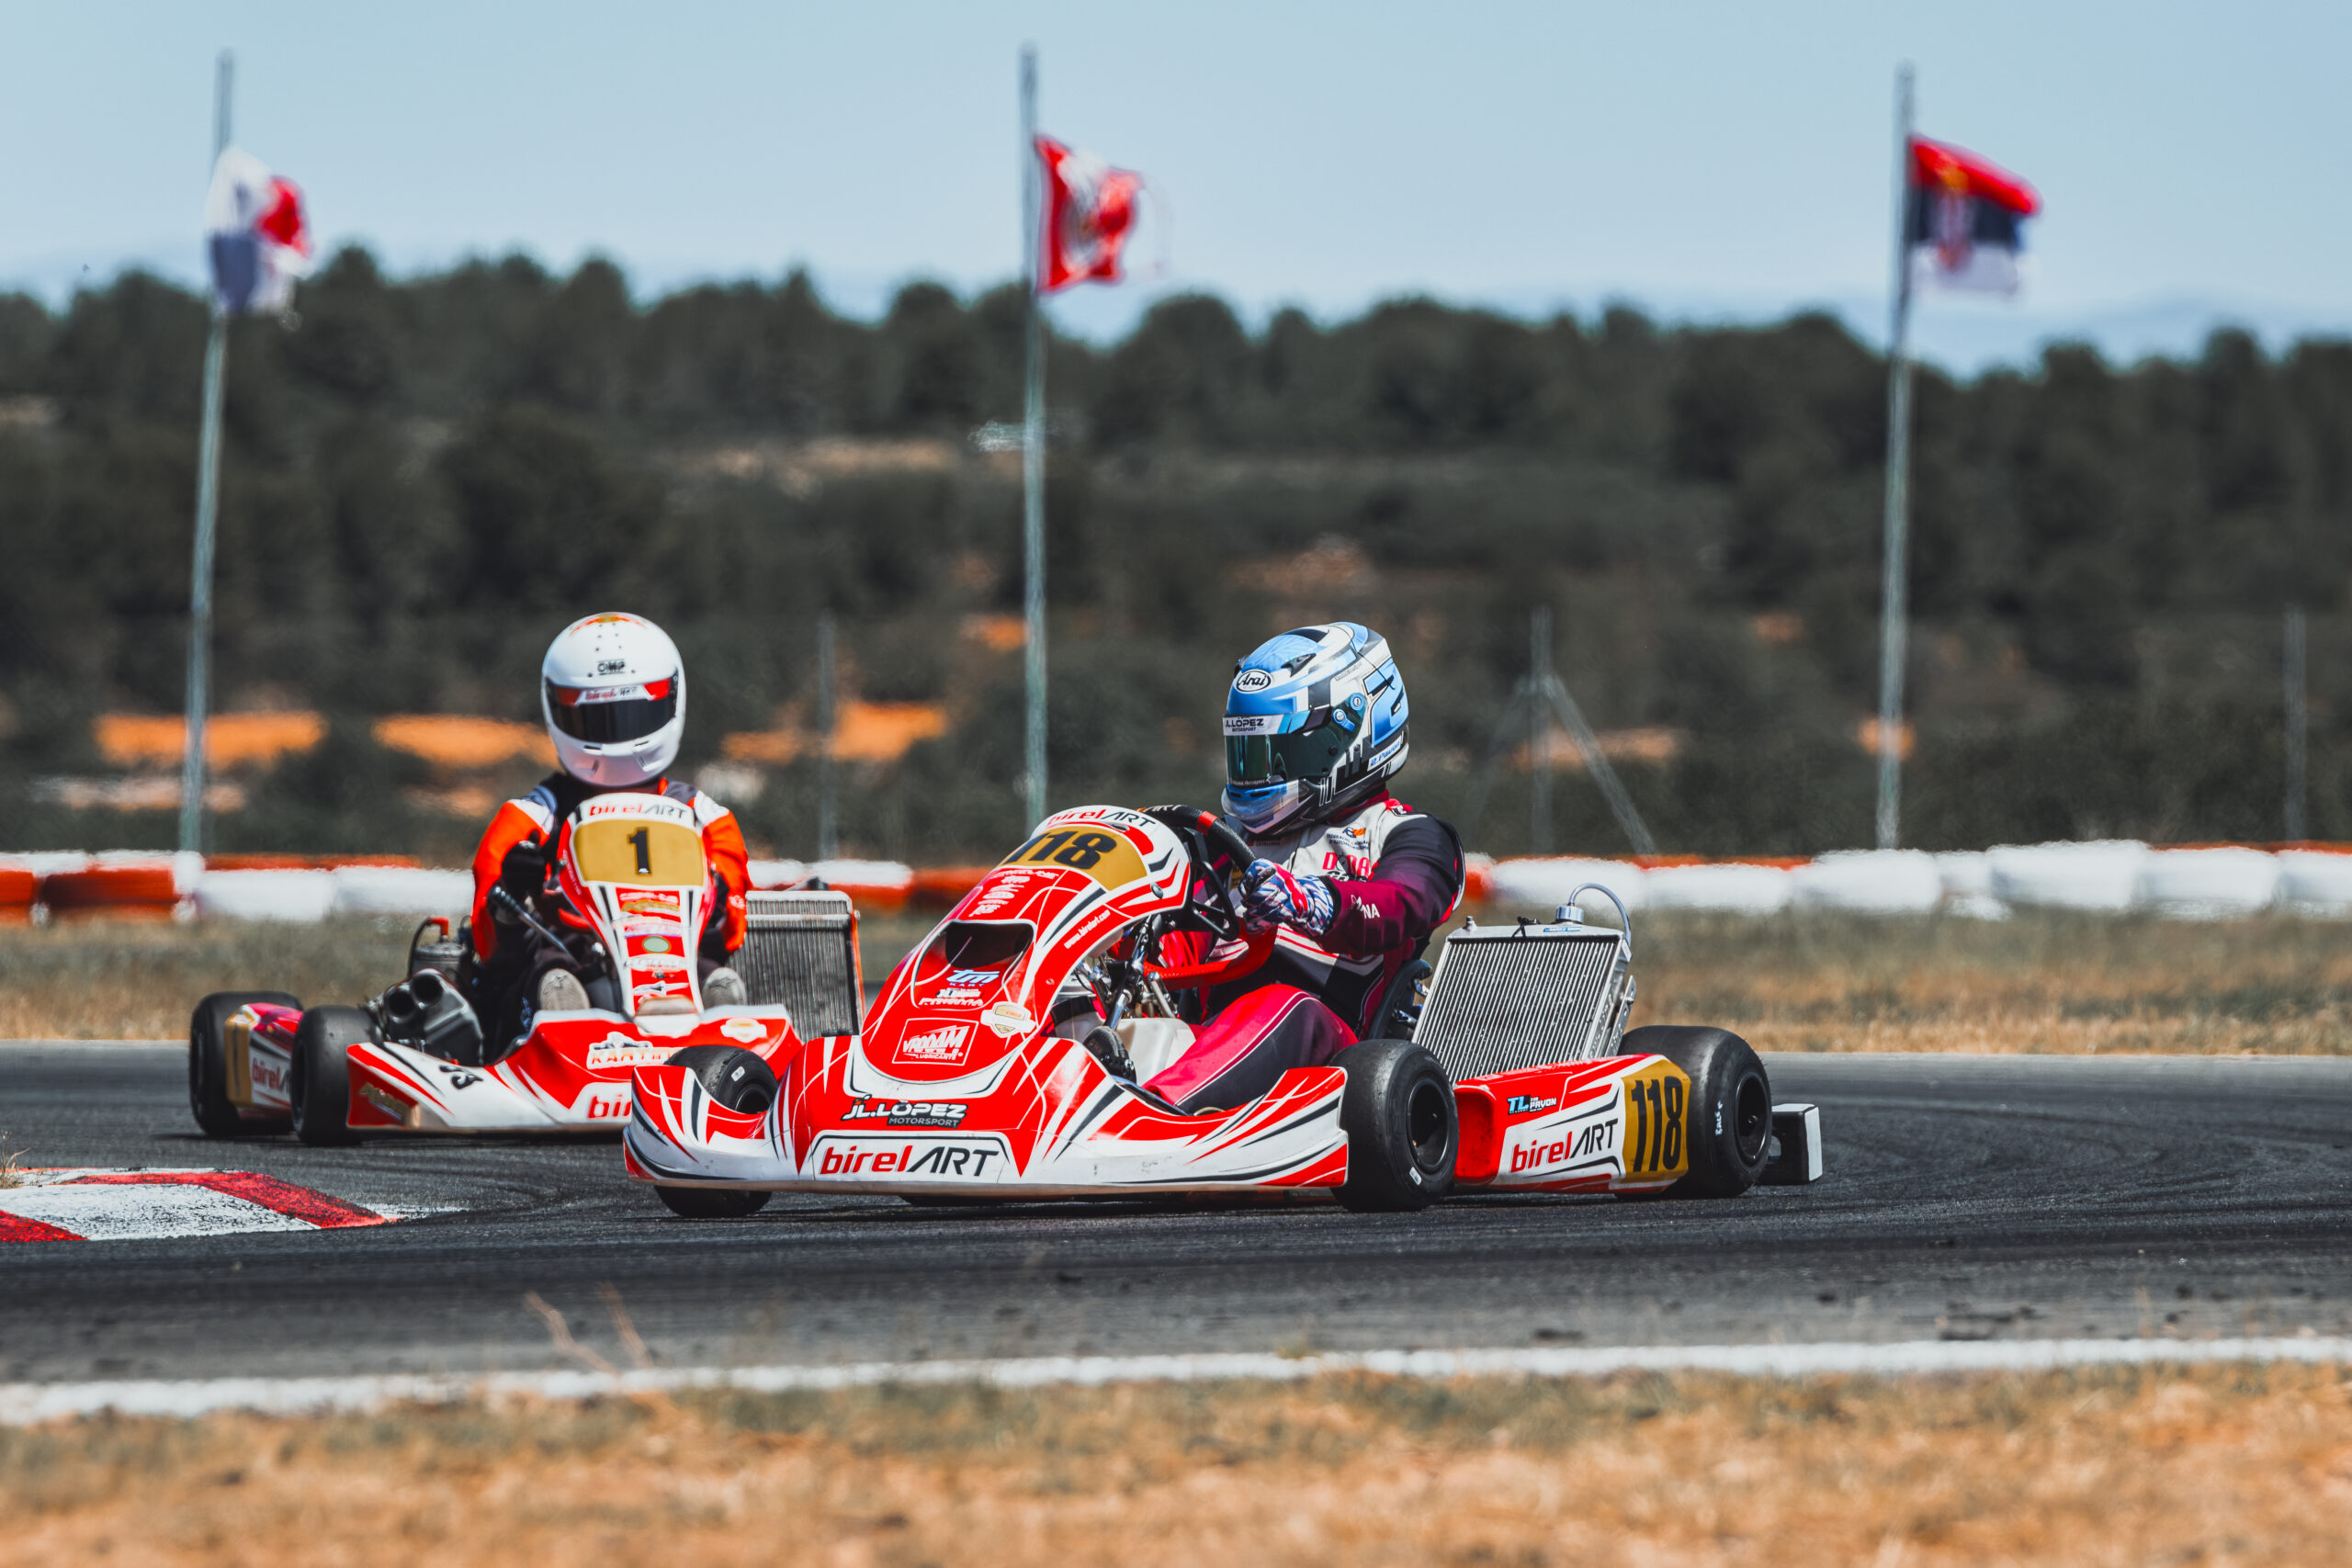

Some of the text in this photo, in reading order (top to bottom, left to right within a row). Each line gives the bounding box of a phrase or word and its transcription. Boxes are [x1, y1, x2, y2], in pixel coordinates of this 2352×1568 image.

[1237, 672, 1267, 687] Arai
[1046, 808, 1156, 828] birelART
[628, 827, 651, 876] 1
[1001, 829, 1118, 871] 118
[888, 1116, 960, 1128] MOTORSPORT
[1630, 1076, 1684, 1173] 118
[819, 1145, 1001, 1177] birelART
[1510, 1117, 1620, 1174] birelART
